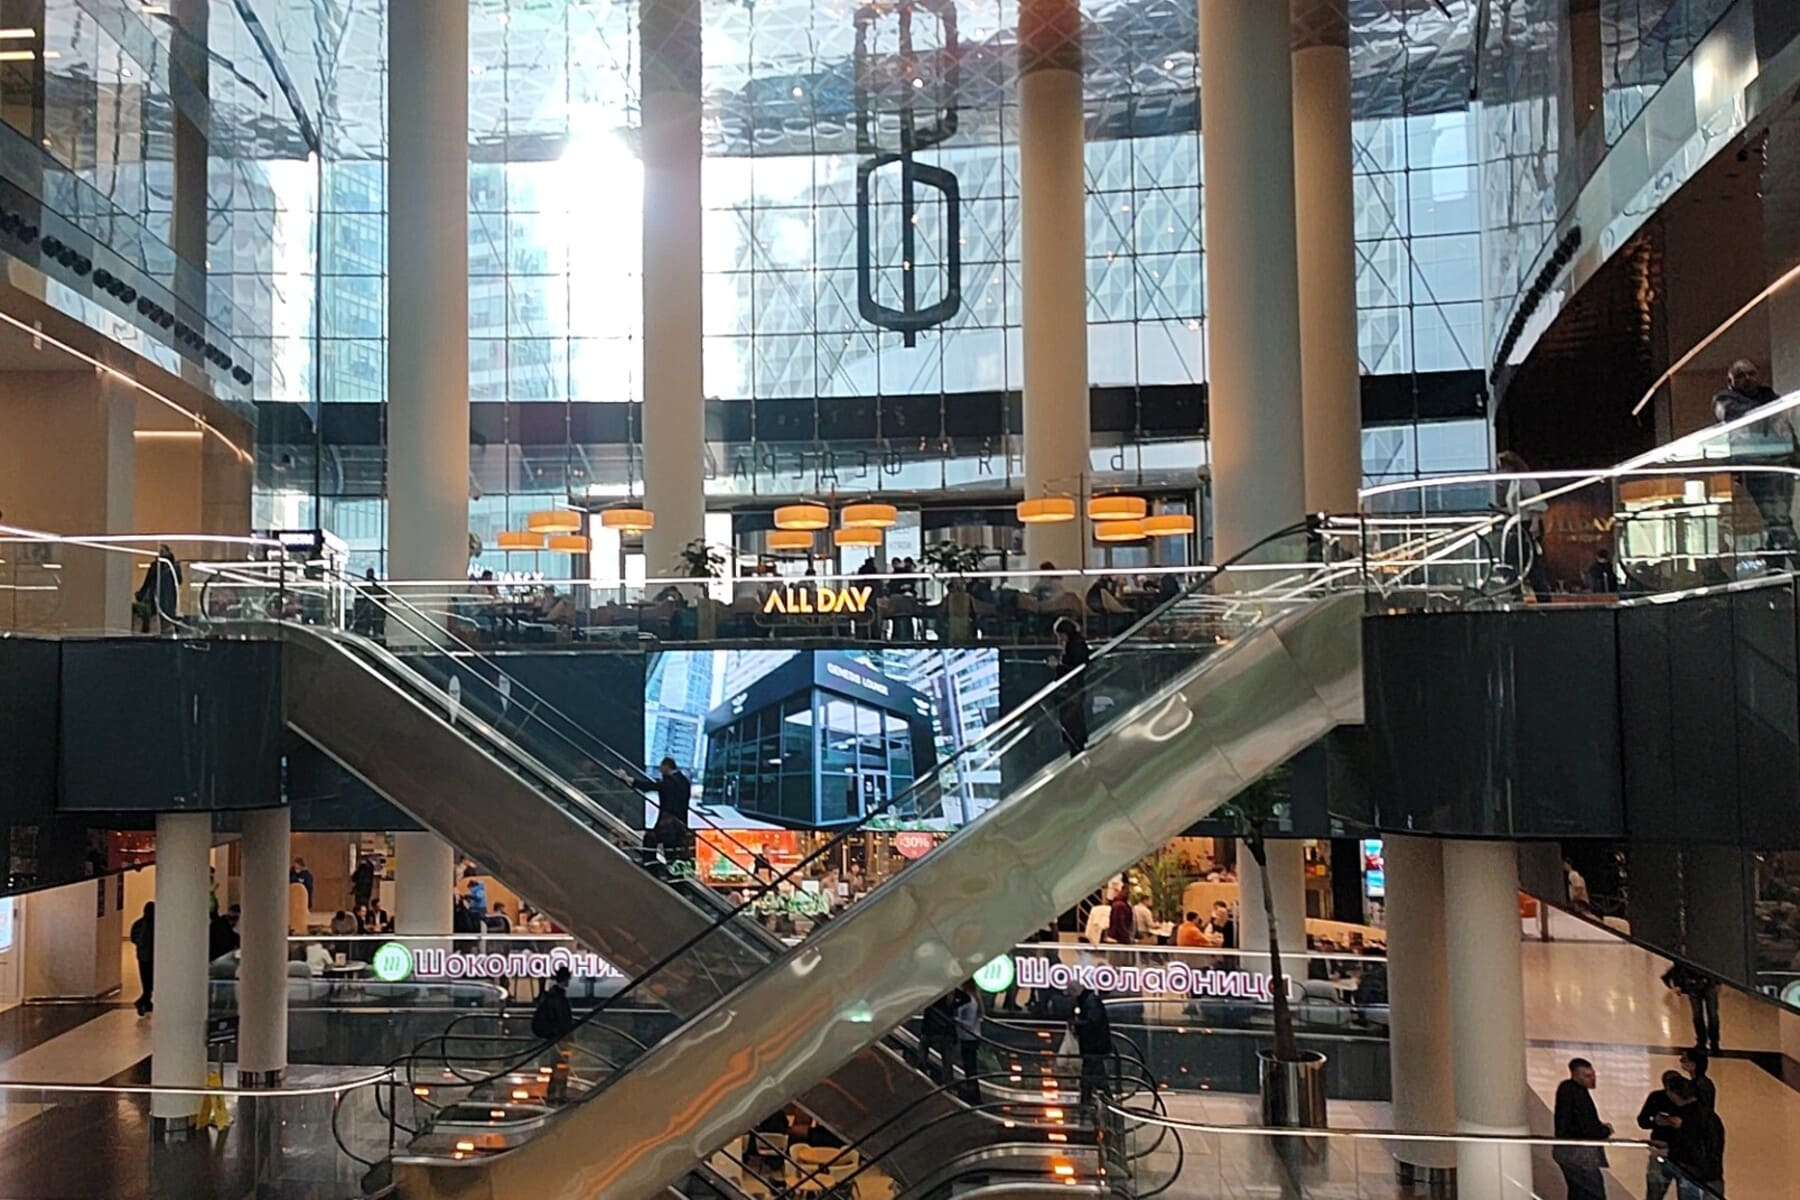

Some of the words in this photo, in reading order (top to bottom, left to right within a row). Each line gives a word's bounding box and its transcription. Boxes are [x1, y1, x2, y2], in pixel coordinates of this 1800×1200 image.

[763, 587, 814, 613] ALL
[816, 586, 873, 612] DAY
[414, 947, 625, 978] Шоколадни
